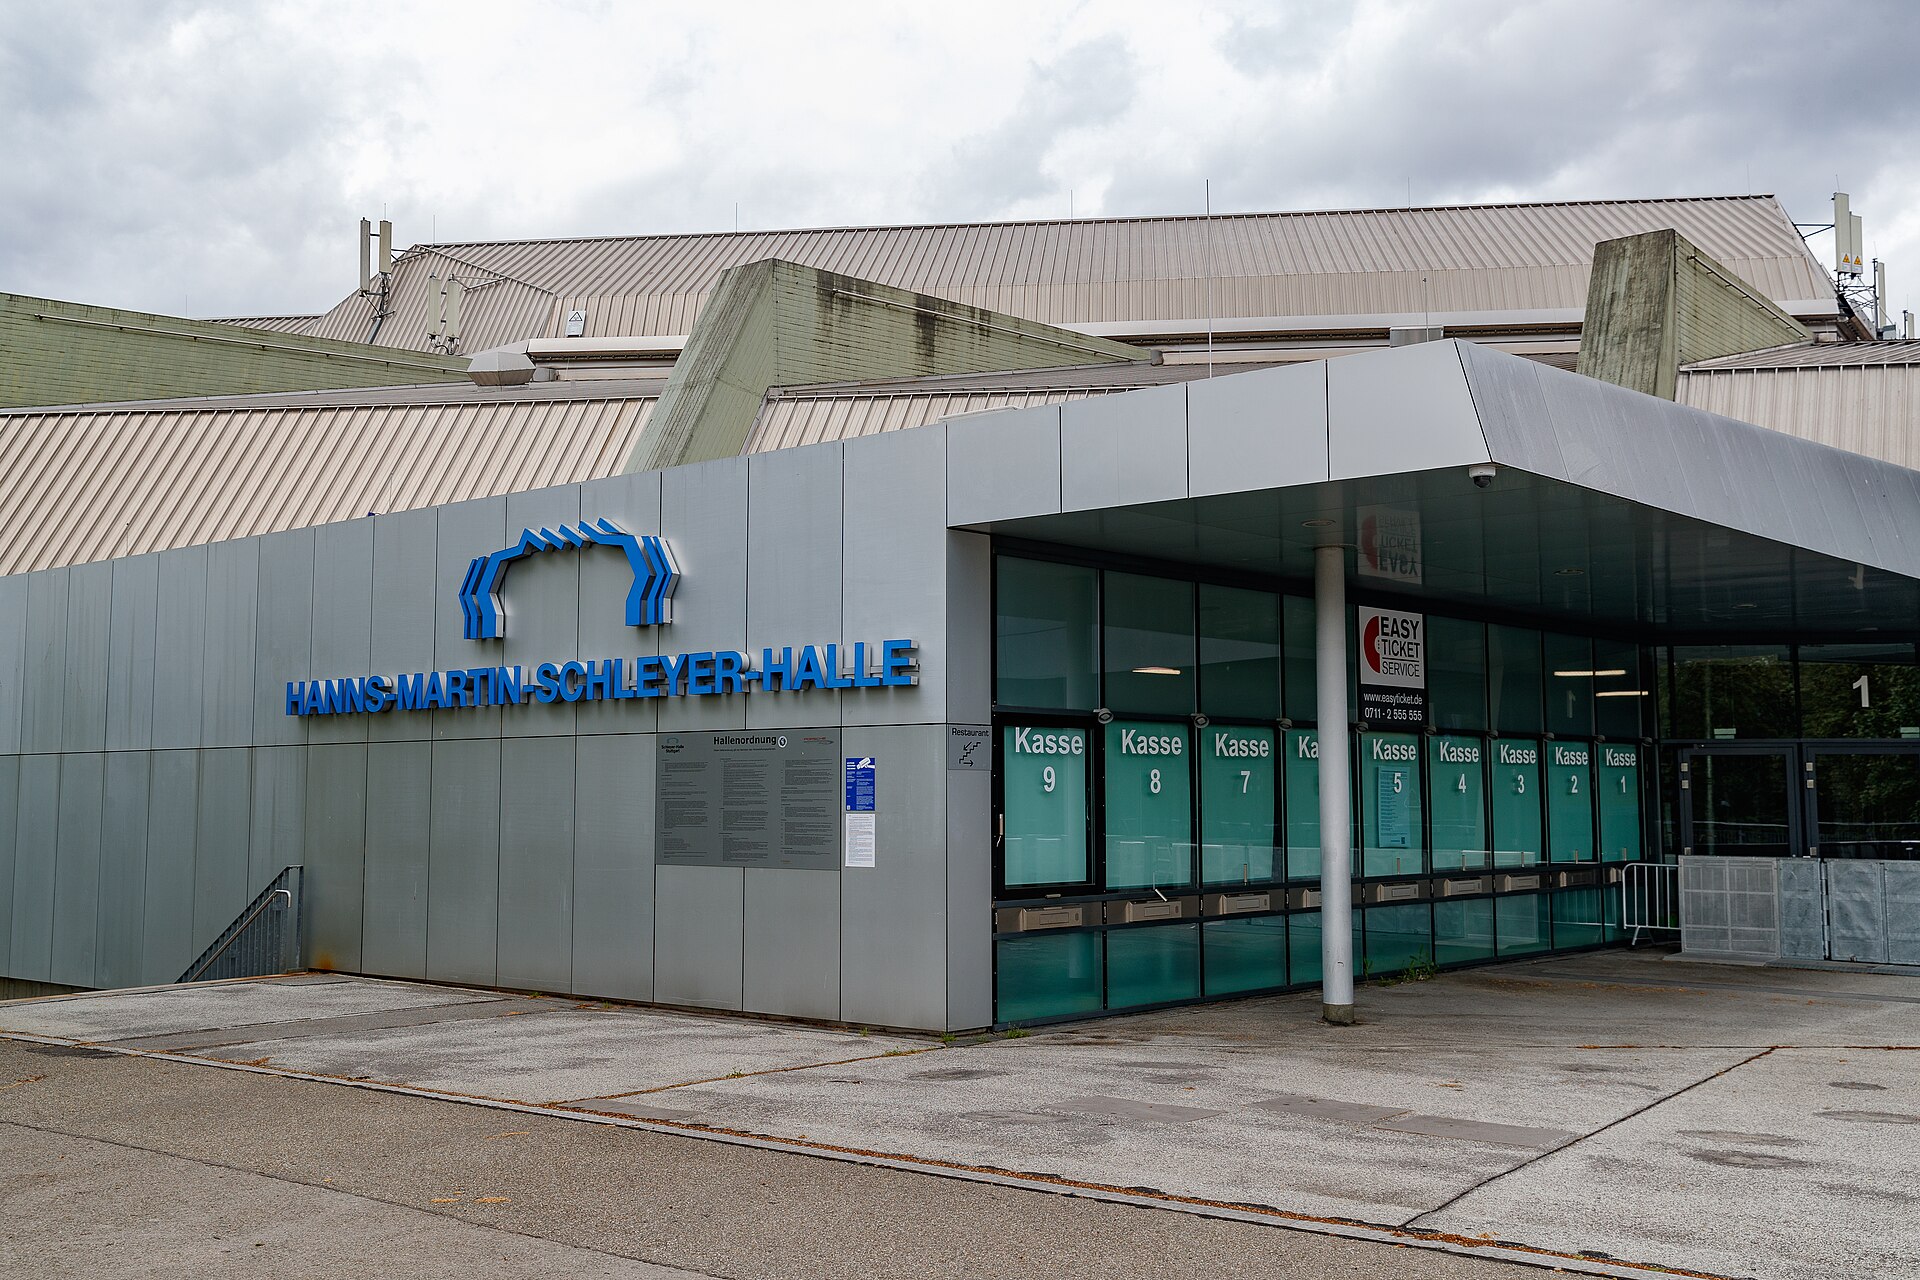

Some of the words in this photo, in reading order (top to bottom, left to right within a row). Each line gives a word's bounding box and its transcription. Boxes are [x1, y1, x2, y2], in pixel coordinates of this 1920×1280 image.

[1381, 616, 1420, 640] EASY
[1381, 639, 1420, 658] TICKET
[286, 639, 919, 716] HANNS-MARTIN-SCHLEYER-HALLE
[1382, 661, 1420, 677] SERVICE
[1364, 693, 1423, 706] www.easyticket.de
[1852, 675, 1870, 708] 1
[1365, 707, 1381, 719] 0711
[1393, 709, 1408, 720] 555
[1408, 710, 1423, 721] 555
[713, 736, 777, 745] Hallenordnung
[951, 727, 990, 737] Restaurant
[1015, 727, 1083, 755] Kasse
[1121, 729, 1182, 755] Kasse
[1215, 733, 1269, 757] Kasse
[1373, 738, 1417, 761] Kasse
[1439, 741, 1480, 763] Kasse
[1500, 744, 1536, 764] Kasse
[1555, 746, 1588, 766] Kasse
[1605, 748, 1637, 766] Kasse
[1043, 766, 1056, 793] 9
[1150, 769, 1161, 794] 8
[1240, 770, 1251, 794] 7
[1393, 772, 1403, 794] 5
[1458, 773, 1467, 793] 4
[1517, 774, 1525, 794] 3
[1571, 775, 1578, 794] 2
[1620, 775, 1626, 794] 1
